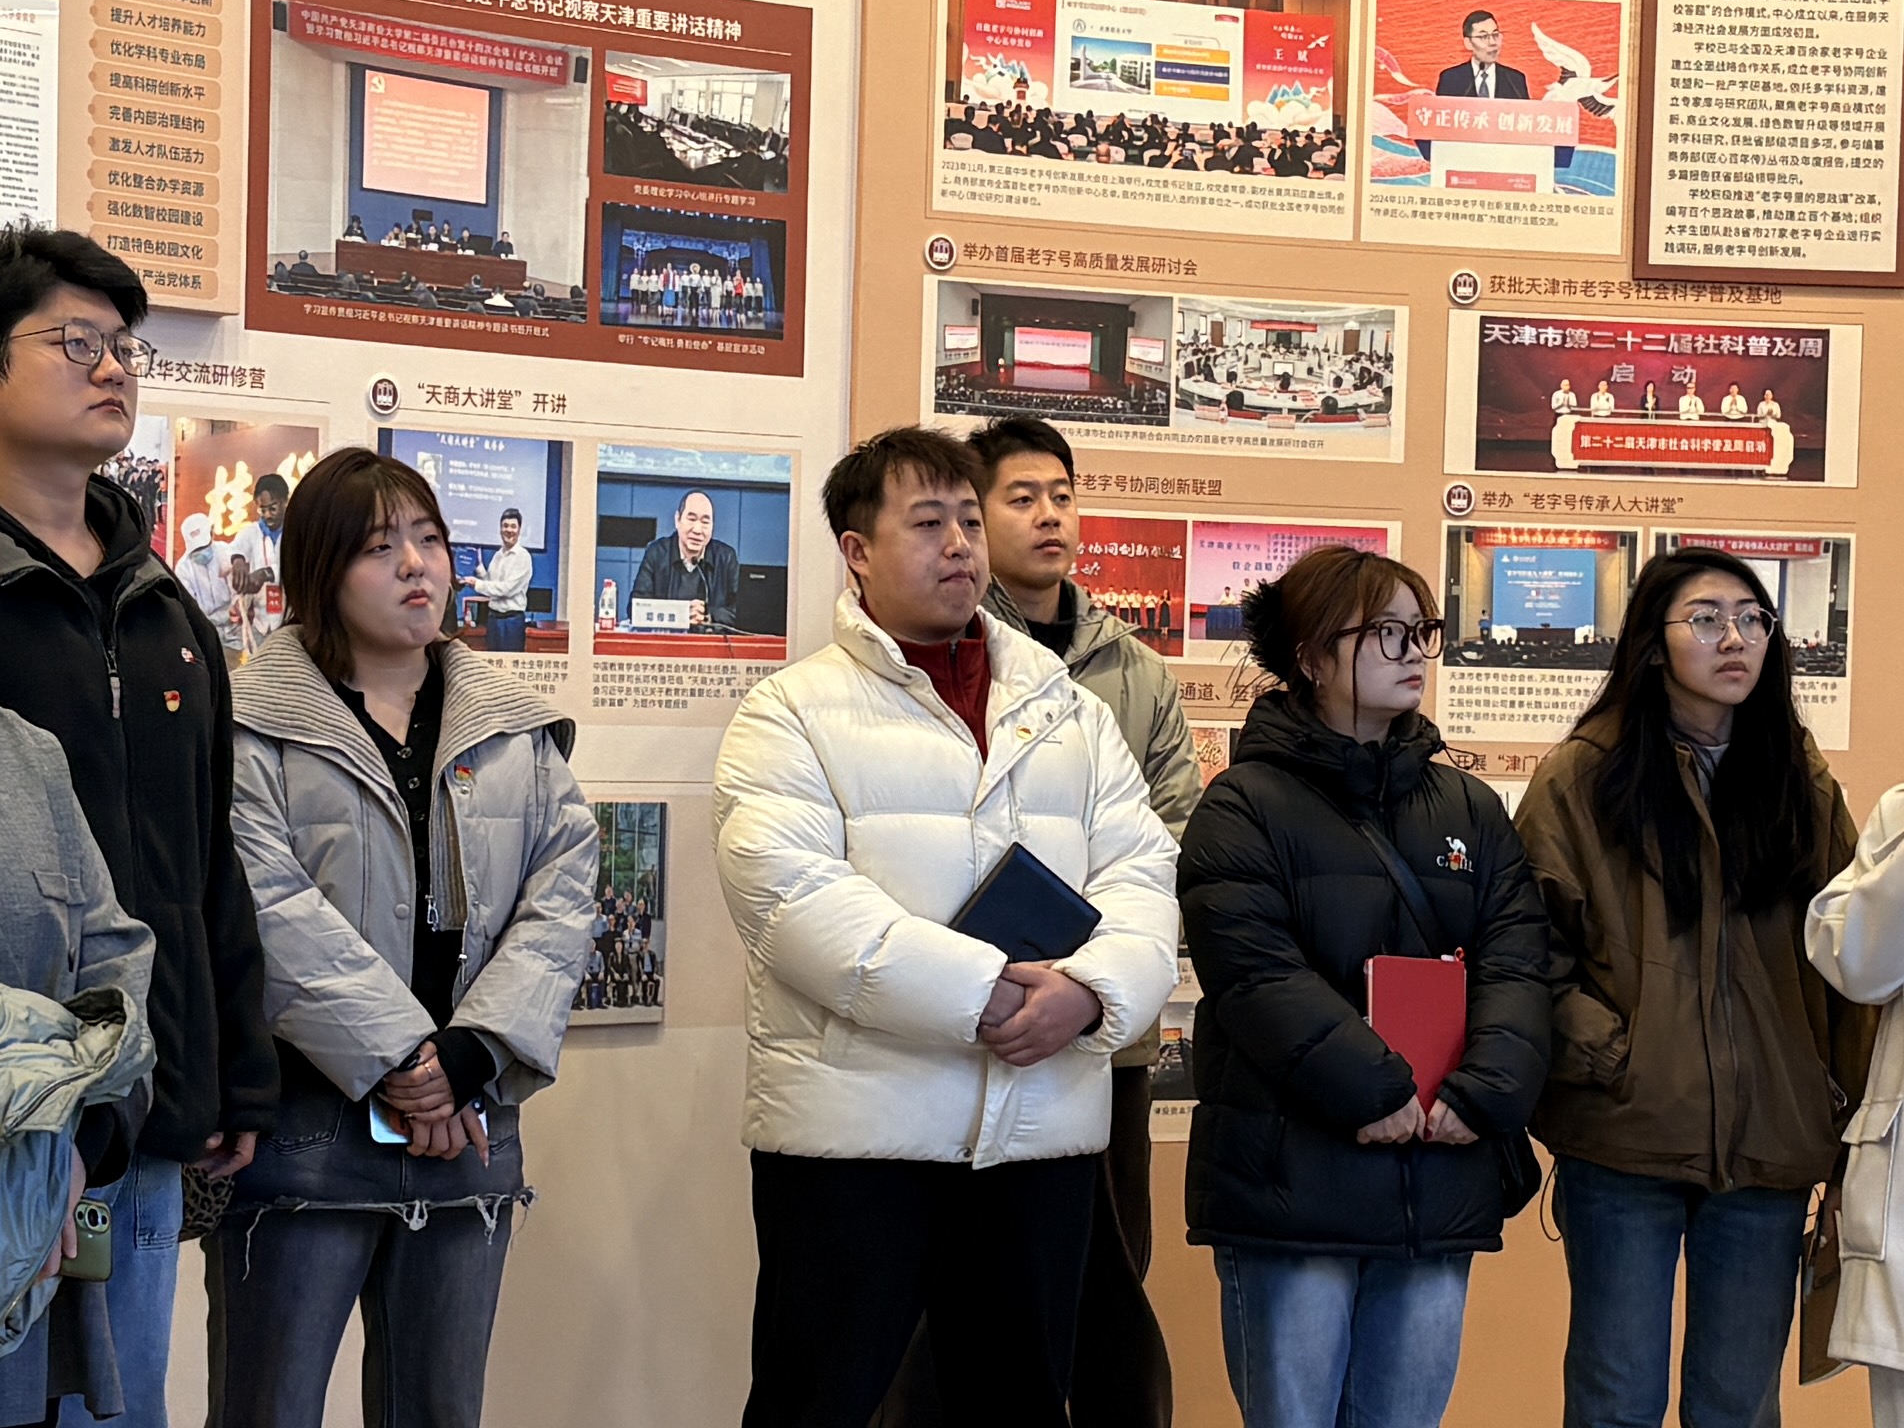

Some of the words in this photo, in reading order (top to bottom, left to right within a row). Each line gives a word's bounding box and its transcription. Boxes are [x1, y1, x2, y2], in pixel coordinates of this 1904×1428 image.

[111, 7, 206, 38] 提升人才培养能力
[111, 40, 205, 70] 优化学科专业布局
[110, 73, 205, 100] 提高科研创新水平
[109, 105, 205, 133] 完善内部治理结构
[1416, 107, 1489, 128] 守正传承
[1498, 112, 1573, 135] 创新发展
[109, 137, 204, 165] 激发人才队伍活力
[108, 171, 204, 197] 优化整合办学资源
[108, 201, 203, 227] 强化数智校园建设
[107, 235, 203, 260] 打造特色校园文化
[963, 243, 1197, 276] 举办首届老字号高质量发展研讨会
[1490, 275, 1782, 305] 获批天津市老字号社会科学普及基地
[1484, 324, 1823, 357] 天津市第二十二届社科普及周
[1611, 363, 1697, 384] 启动
[417, 378, 521, 411] “天商大讲堂”
[531, 391, 567, 415] 开讲
[1482, 492, 1514, 508] 举办
[1523, 493, 1684, 514] “老字号传承人大讲堂”
